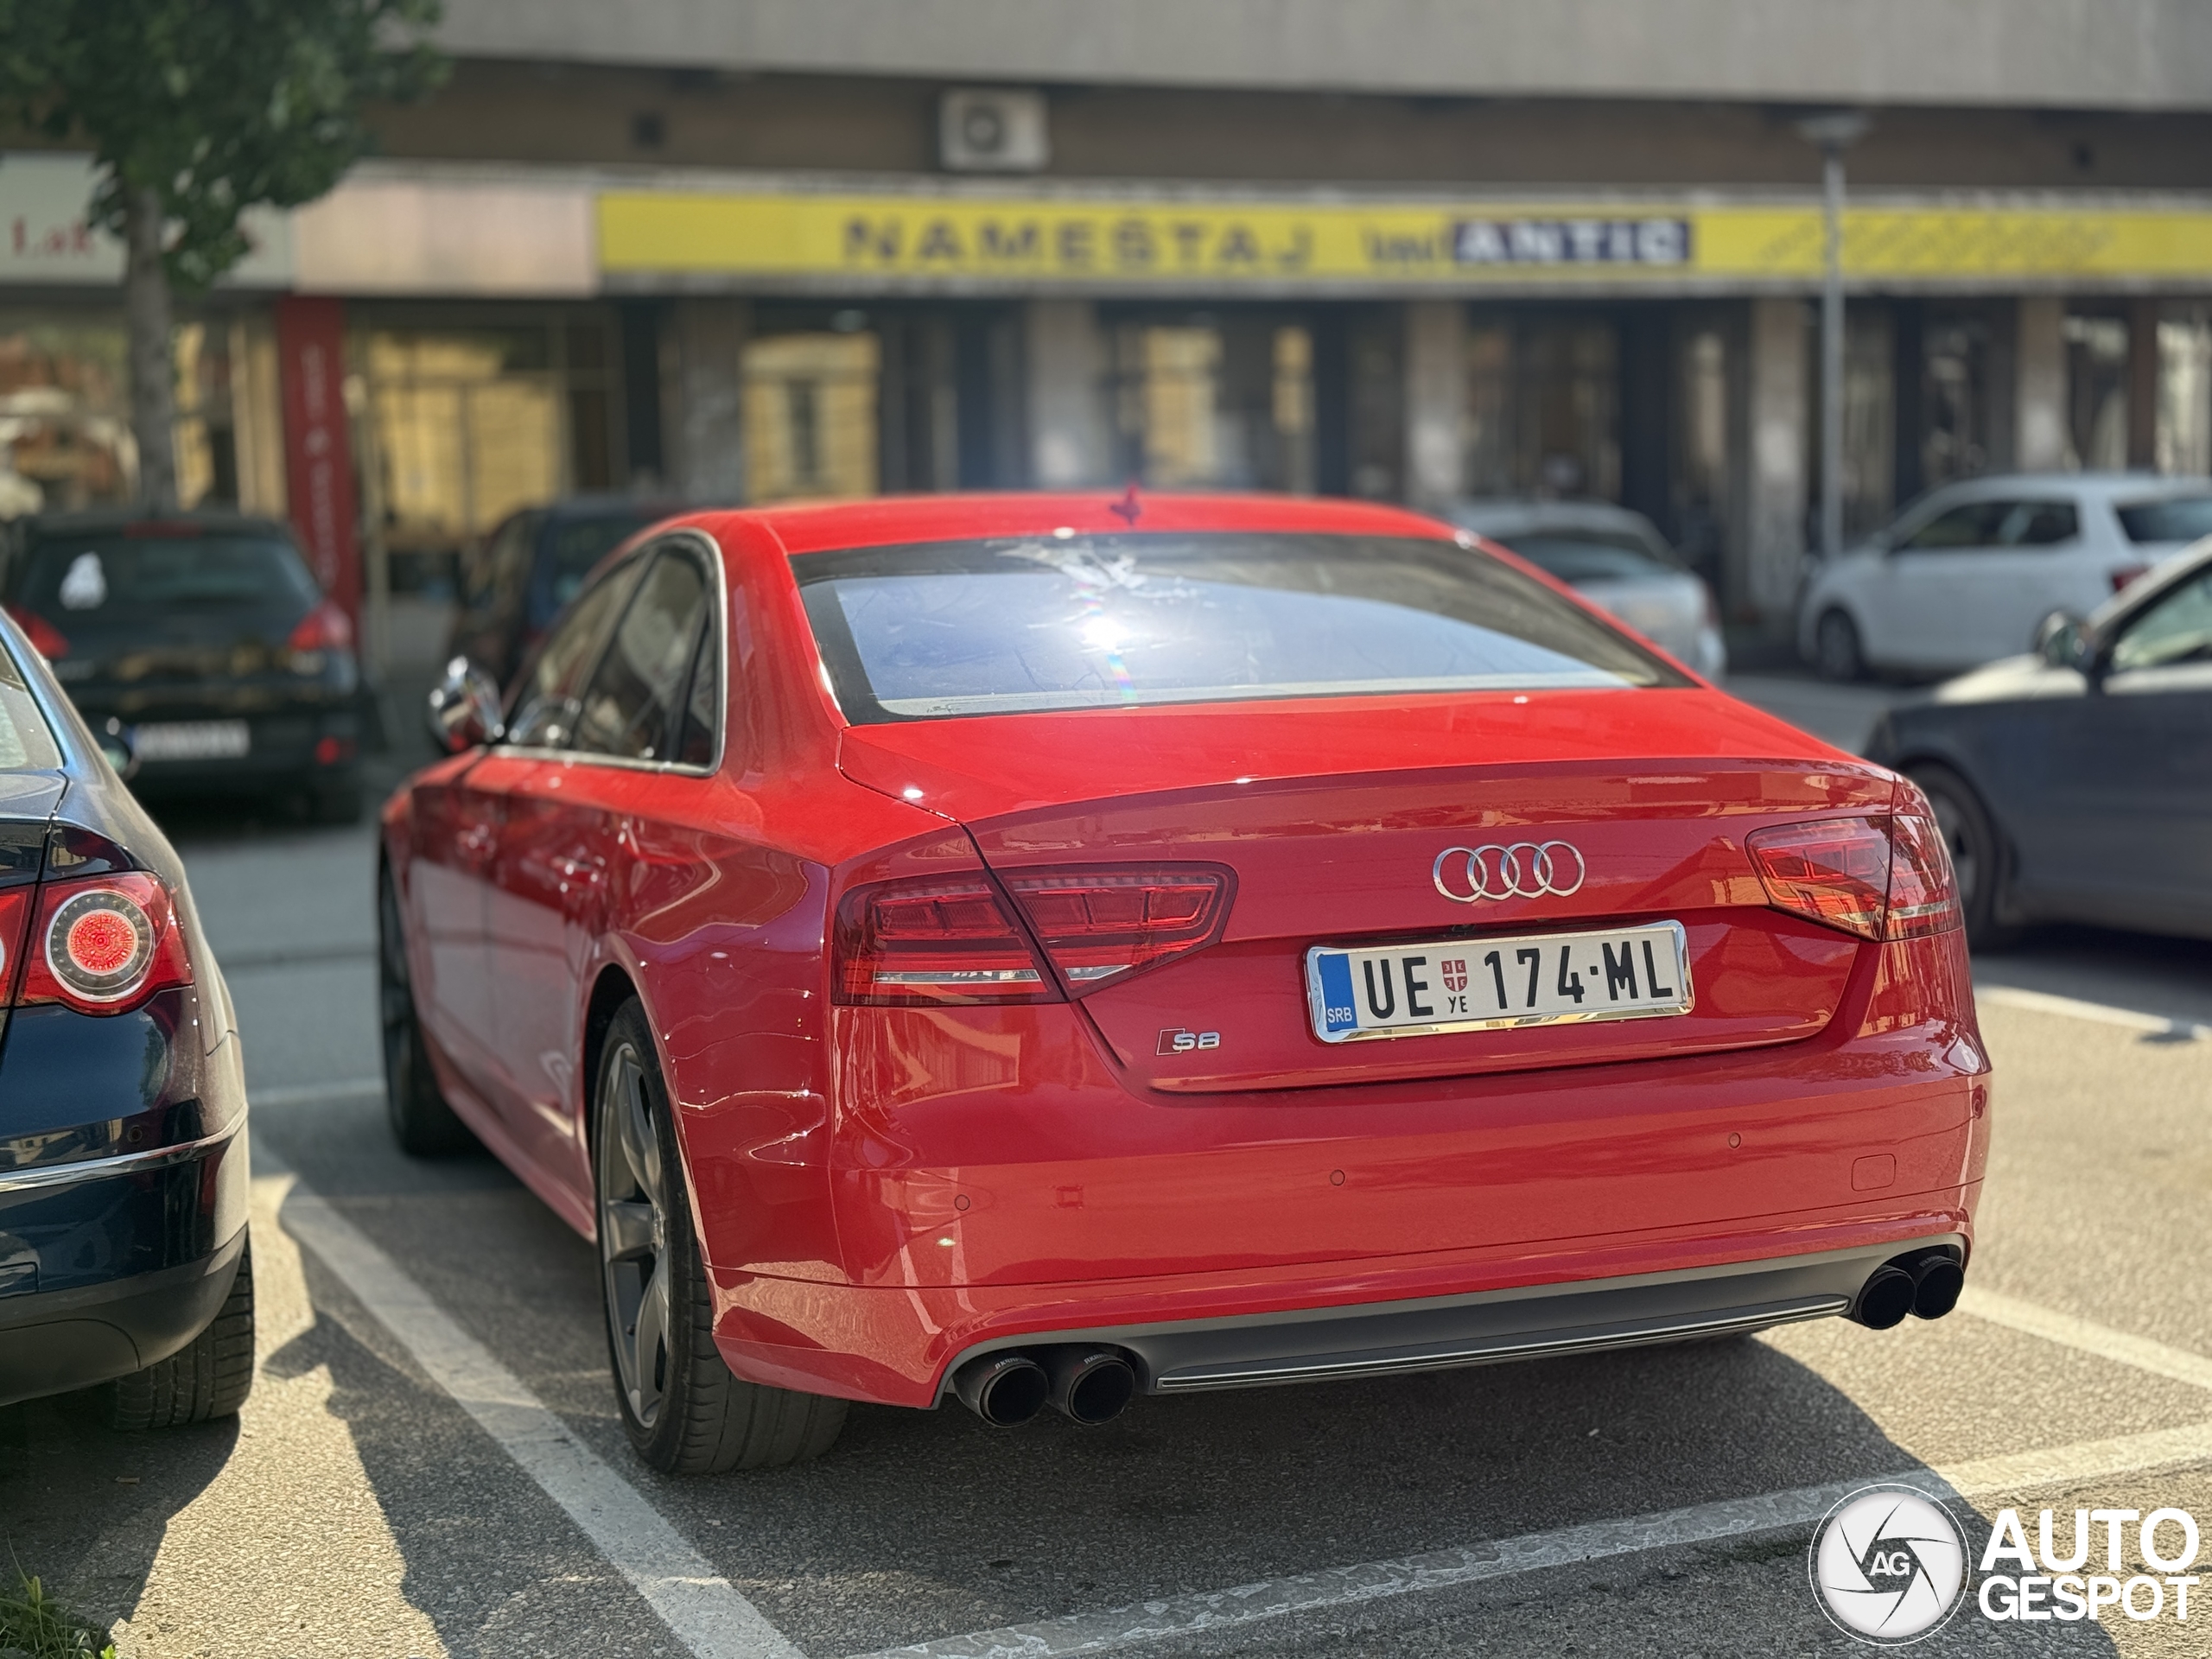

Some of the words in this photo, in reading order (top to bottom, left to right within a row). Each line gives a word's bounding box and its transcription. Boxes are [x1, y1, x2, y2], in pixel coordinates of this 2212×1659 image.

[1363, 956, 1434, 1020] UE
[1326, 1006, 1353, 1023] SRB
[1172, 1032, 1220, 1051] S8
